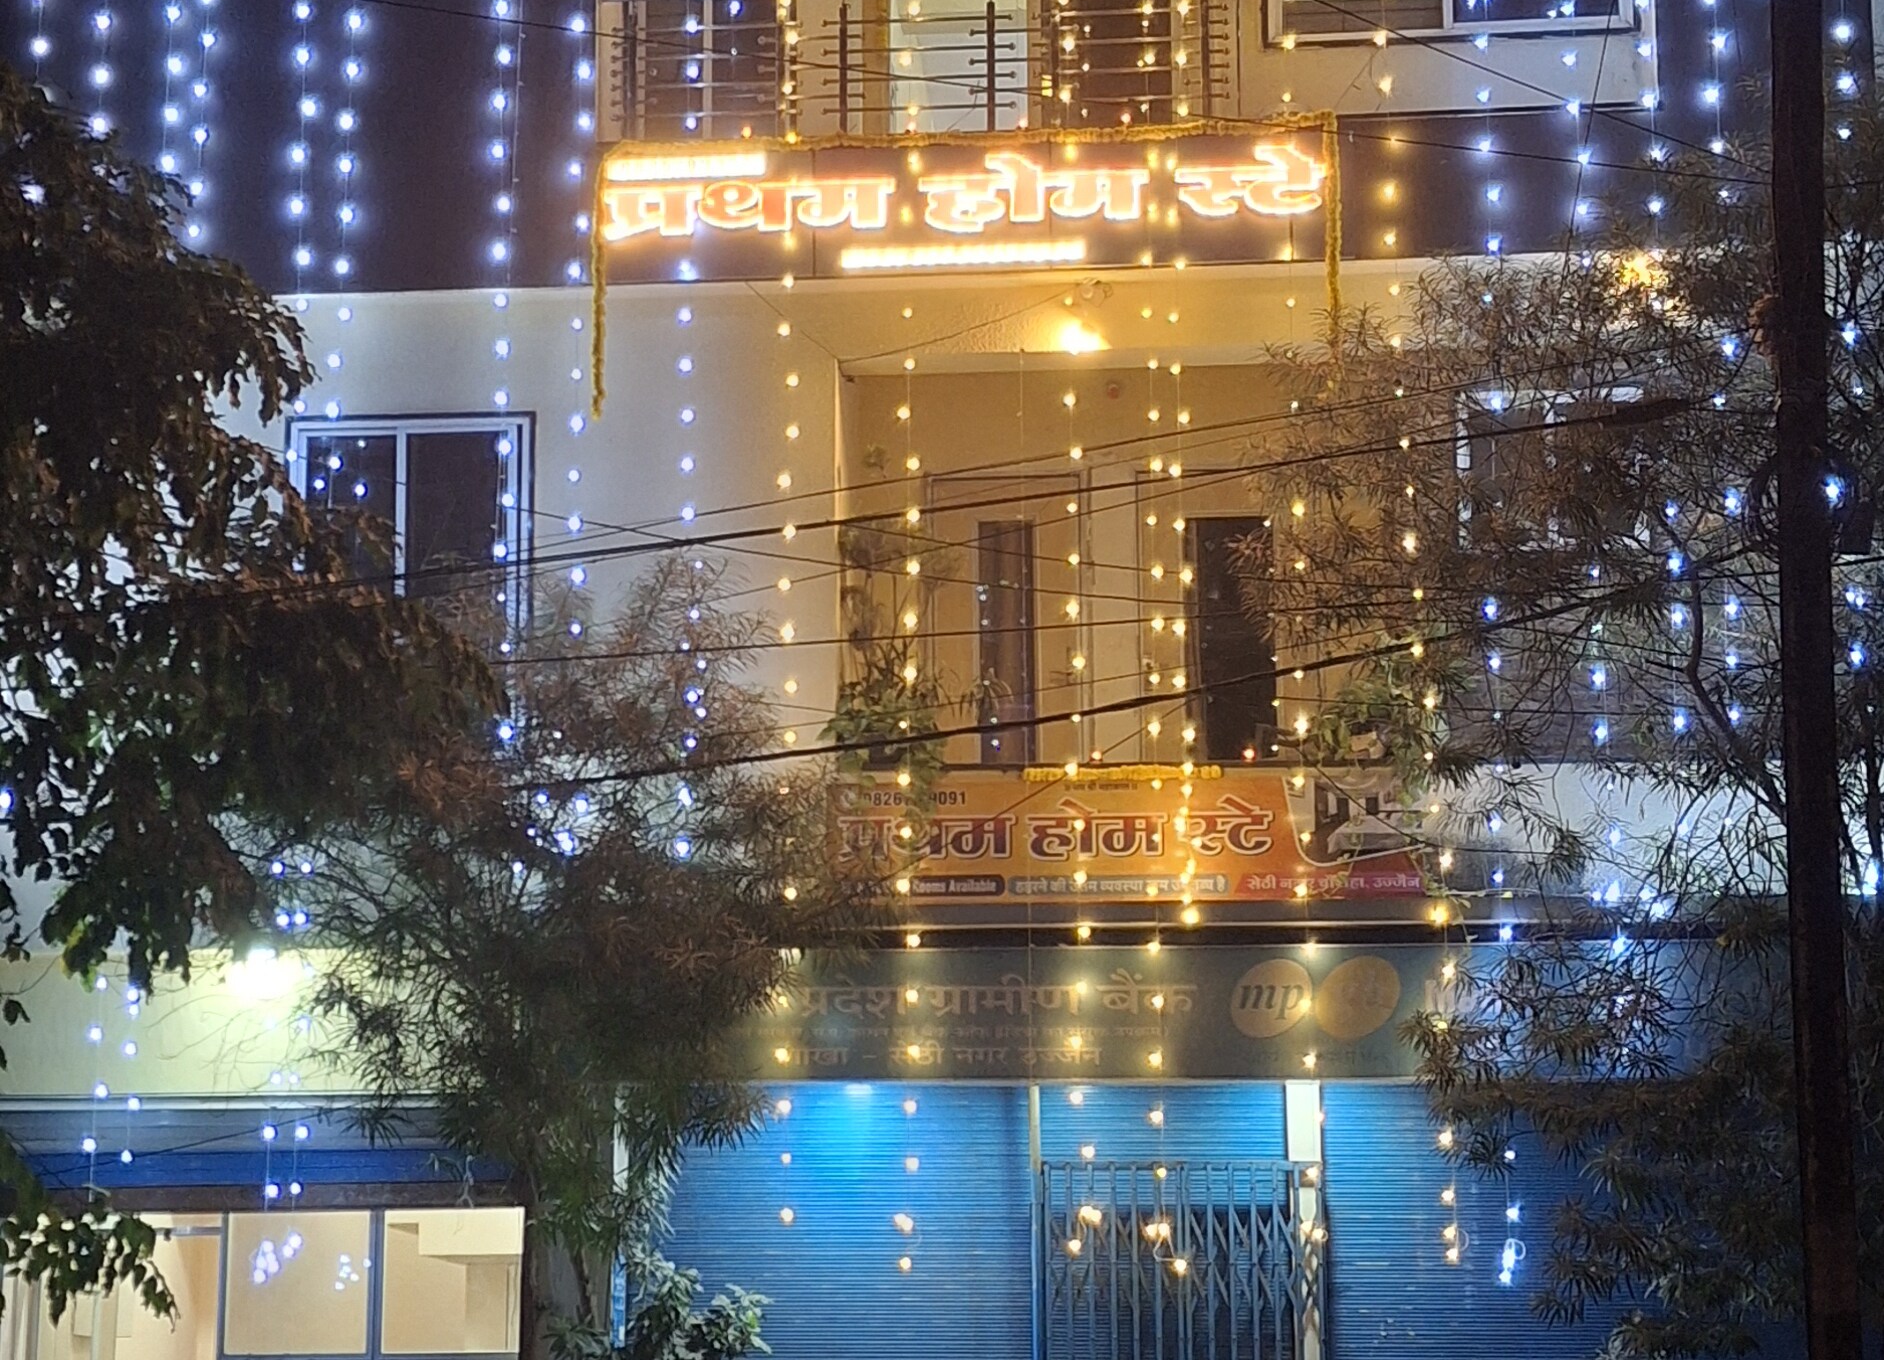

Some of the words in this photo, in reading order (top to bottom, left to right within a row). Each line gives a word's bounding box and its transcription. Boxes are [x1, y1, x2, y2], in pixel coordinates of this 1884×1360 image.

[604, 176, 895, 241] प्रथम
[918, 152, 1150, 233] होम
[1173, 144, 1329, 217] स्टे
[1027, 796, 1168, 862] होम
[1180, 794, 1273, 856] स्टे
[1246, 874, 1277, 890] सेठी
[1371, 873, 1421, 889] उज्जैन
[922, 973, 1083, 1018] ग्रामीण
[1096, 967, 1199, 1015] बैंक
[1237, 980, 1304, 1021] mp
[951, 1047, 1008, 1067] नगर
